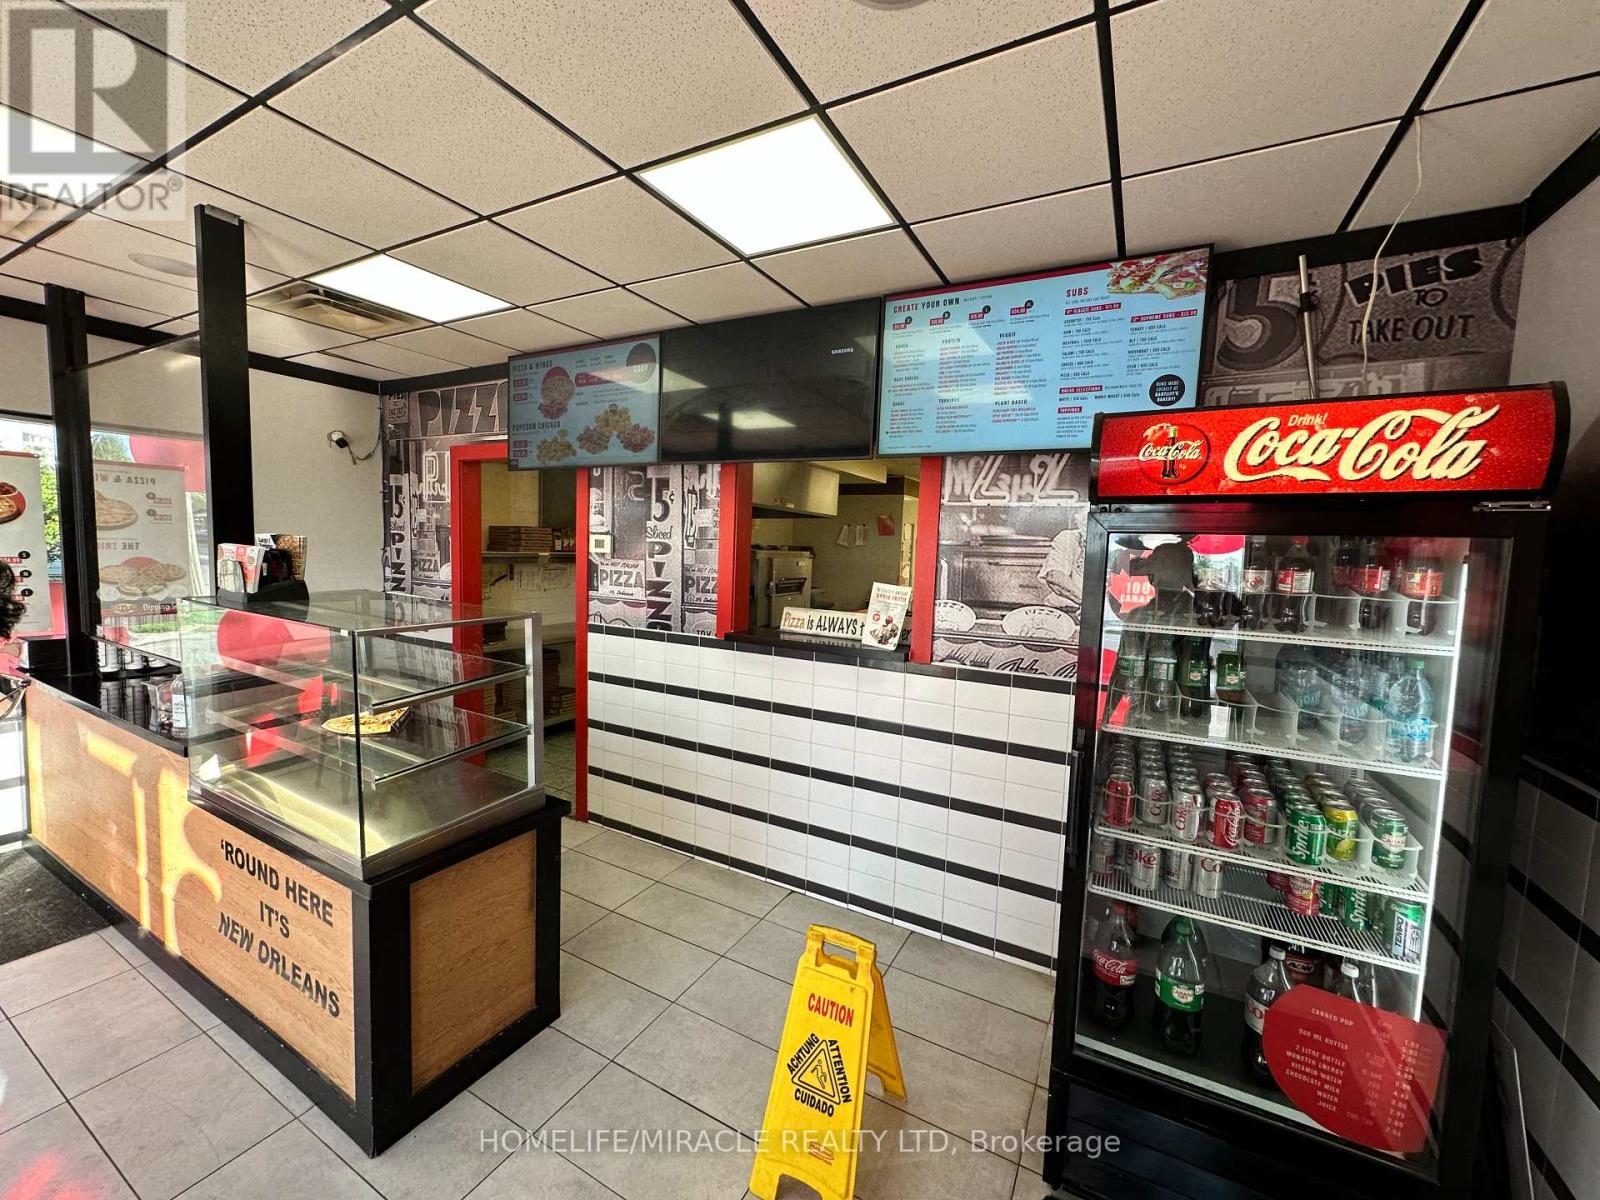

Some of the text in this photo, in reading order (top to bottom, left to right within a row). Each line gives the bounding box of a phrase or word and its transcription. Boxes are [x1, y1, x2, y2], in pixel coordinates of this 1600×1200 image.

[1345, 248, 1483, 307] PIES
[1066, 286, 1089, 297] SUBS
[1416, 288, 1448, 307] TO
[893, 303, 919, 314] CREATE
[922, 300, 940, 310] YOUR
[943, 297, 960, 306] OWN
[1349, 314, 1475, 345] TAKE OUT
[512, 364, 527, 372] PIZZA
[417, 381, 508, 436] PIZZ
[1287, 412, 1329, 427] Drink!
[1138, 436, 1203, 461] Coca-Cola
[1223, 404, 1501, 482] Coca-Cola
[645, 525, 674, 539] Sliced
[413, 558, 440, 573] PIZZA
[599, 569, 644, 589] PIZZA
[782, 612, 805, 629] Pizza
[806, 616, 814, 630] is
[816, 615, 858, 636] ALWAYS
[1291, 819, 1311, 860] Sprite
[285, 877, 333, 927] HERE
[259, 900, 290, 939] IT'S
[1395, 916, 1404, 947] TEMPO
[218, 912, 340, 1018] NEW ORLEANS
[808, 993, 855, 1028] CAUTION
[1311, 1008, 1354, 1026] CANNED POP
[786, 1032, 819, 1075] ACHTUNG
[1324, 1037, 1349, 1050] BOTTLE
[1286, 1050, 1317, 1066] MONSTER
[1322, 1054, 1345, 1067] BOTTLE
[828, 1039, 852, 1104] ATTENTION
[1285, 1069, 1341, 1094] CHOCOLATE MILK
[1320, 1072, 1342, 1085] WATER
[794, 1087, 835, 1118] CUIDADO
[1316, 1090, 1339, 1103] WATER
[1318, 1100, 1337, 1112] JUICE
